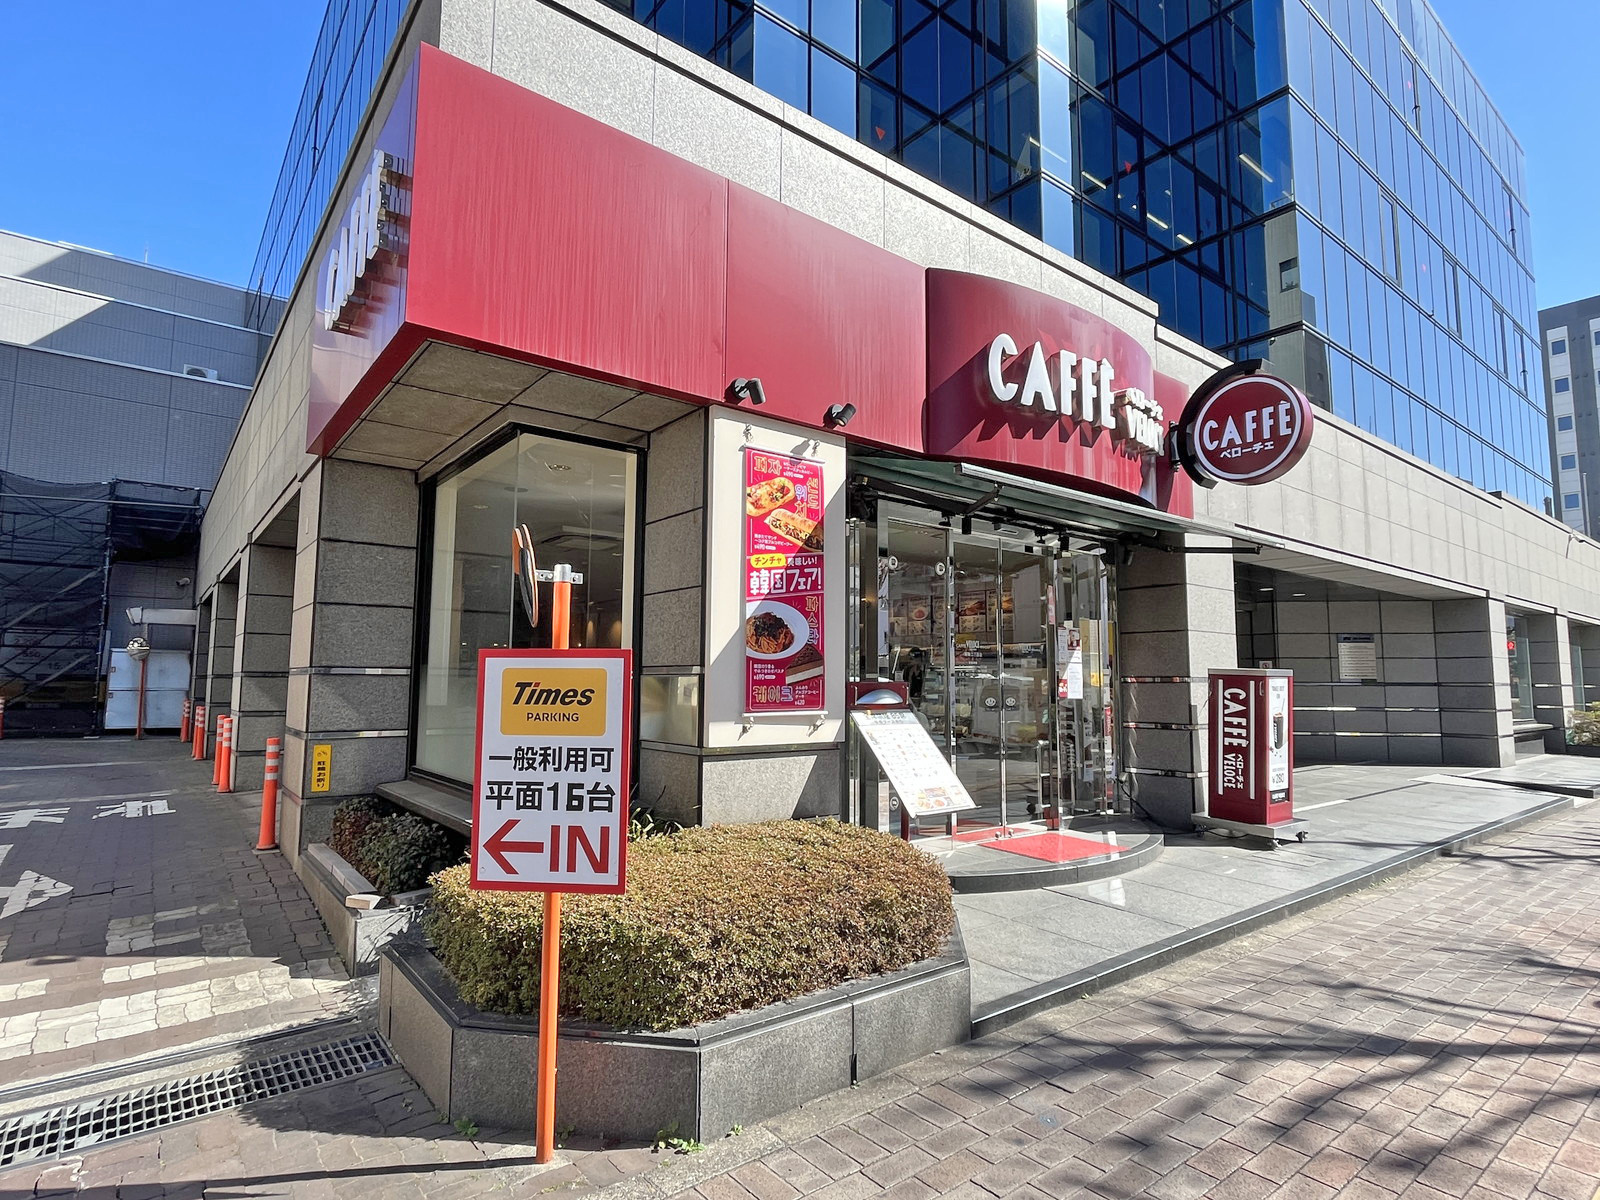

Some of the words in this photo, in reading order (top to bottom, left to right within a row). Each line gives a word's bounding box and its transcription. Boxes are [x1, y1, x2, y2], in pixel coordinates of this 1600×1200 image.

[1220, 441, 1274, 458] ベローチェ
[753, 456, 782, 475] 피자
[754, 556, 782, 566] チンチャ
[512, 681, 595, 706] Times
[752, 685, 794, 703] 케이크
[526, 712, 580, 722] PARKING
[488, 746, 615, 773] 一般利用可
[1223, 753, 1236, 788] VELOCE
[485, 780, 616, 813] 平面16台
[549, 824, 611, 874] IN
